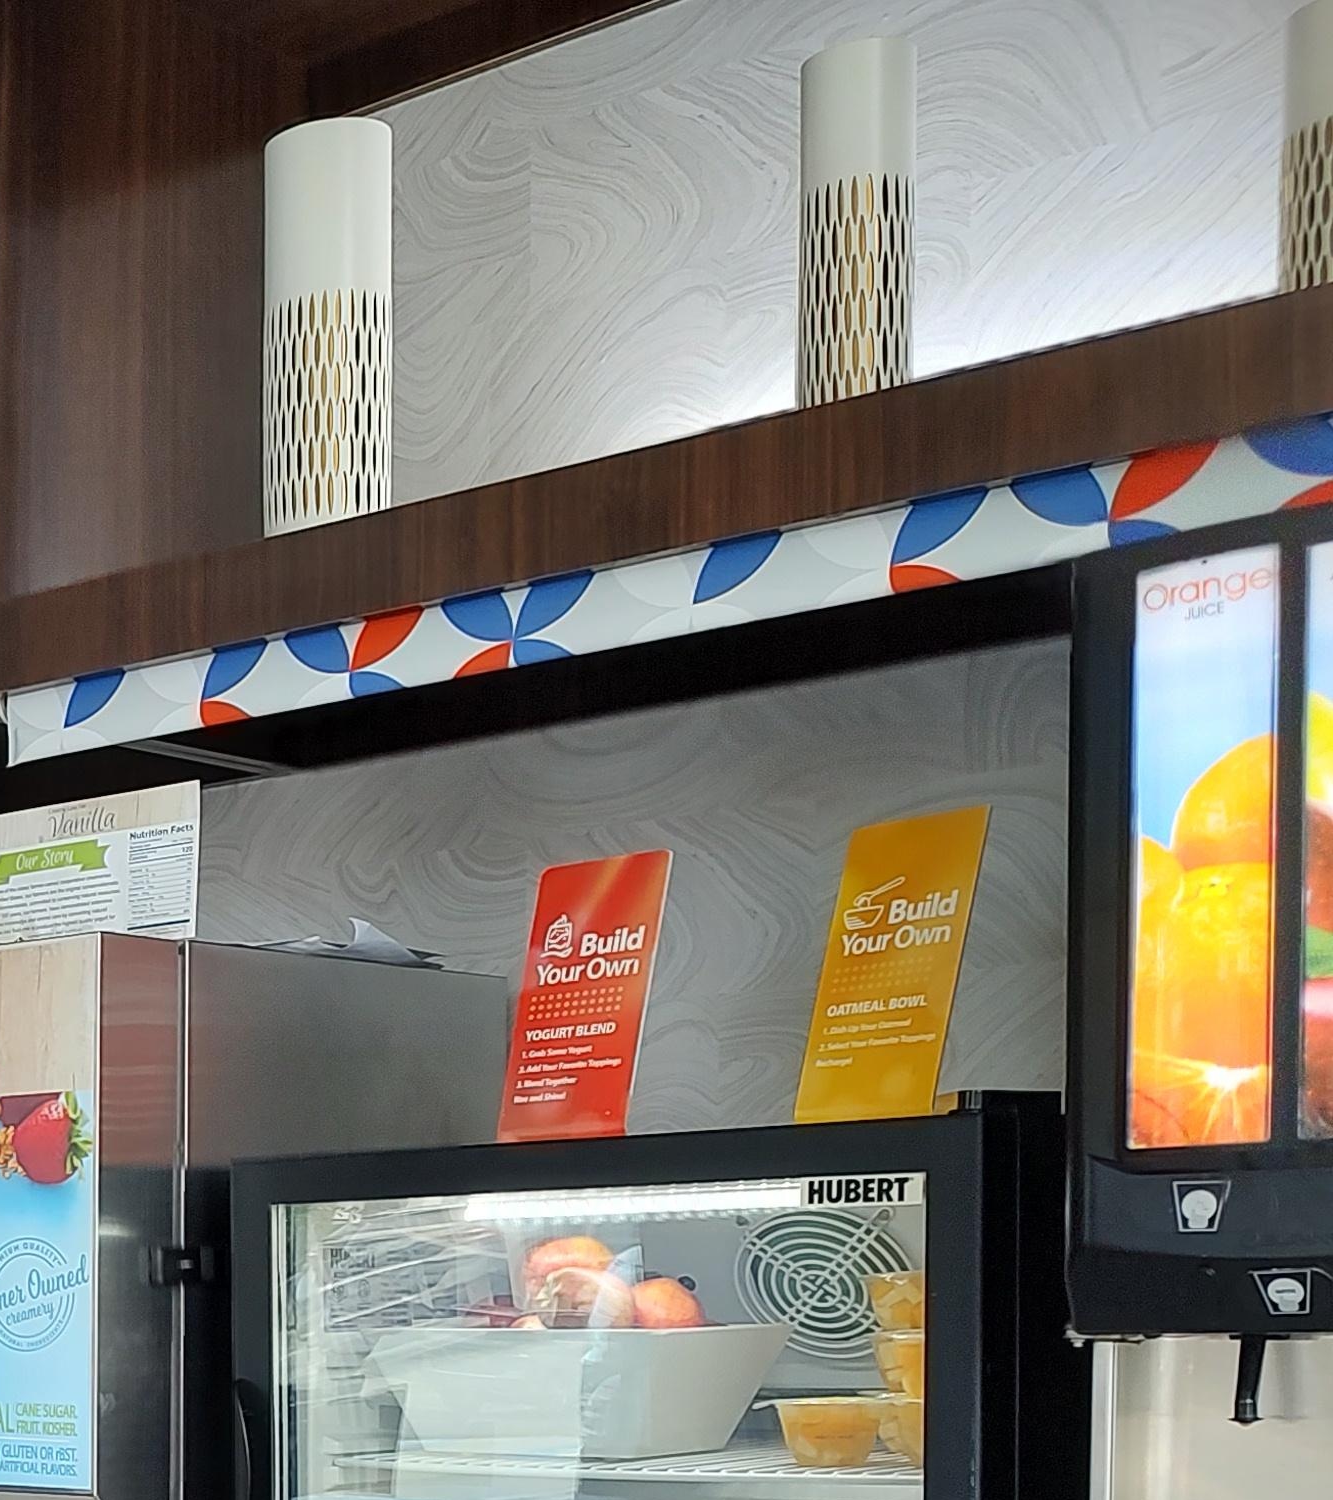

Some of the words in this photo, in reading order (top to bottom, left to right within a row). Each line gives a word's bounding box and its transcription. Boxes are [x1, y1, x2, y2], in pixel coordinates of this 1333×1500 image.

[1143, 568, 1273, 611] Orange
[1184, 602, 1225, 621] JUICE
[48, 806, 117, 838] Vanilla
[129, 827, 169, 841] Nutrition
[171, 823, 194, 835] Facts
[16, 853, 38, 871] Our
[41, 849, 74, 869] Story
[887, 889, 959, 924] Build
[579, 925, 646, 957] Build
[841, 932, 893, 956] Your
[894, 925, 951, 949] Own
[537, 964, 585, 986] Your
[586, 957, 640, 980] Own
[826, 1000, 886, 1017] OATMEAL
[888, 994, 928, 1010] BOWL
[525, 1025, 575, 1042] YOGURT
[575, 1022, 617, 1037] BLEND
[808, 1177, 910, 1204] HUBERT
[22, 1241, 58, 1262] QUALITY
[27, 1254, 90, 1299] Owned
[5, 1301, 54, 1326] creamery
[15, 1403, 41, 1417] CANE
[1, 1444, 38, 1459] GLUTEN
[39, 1446, 54, 1460] OR
[0, 1460, 40, 1474] ARTIFICIAL
